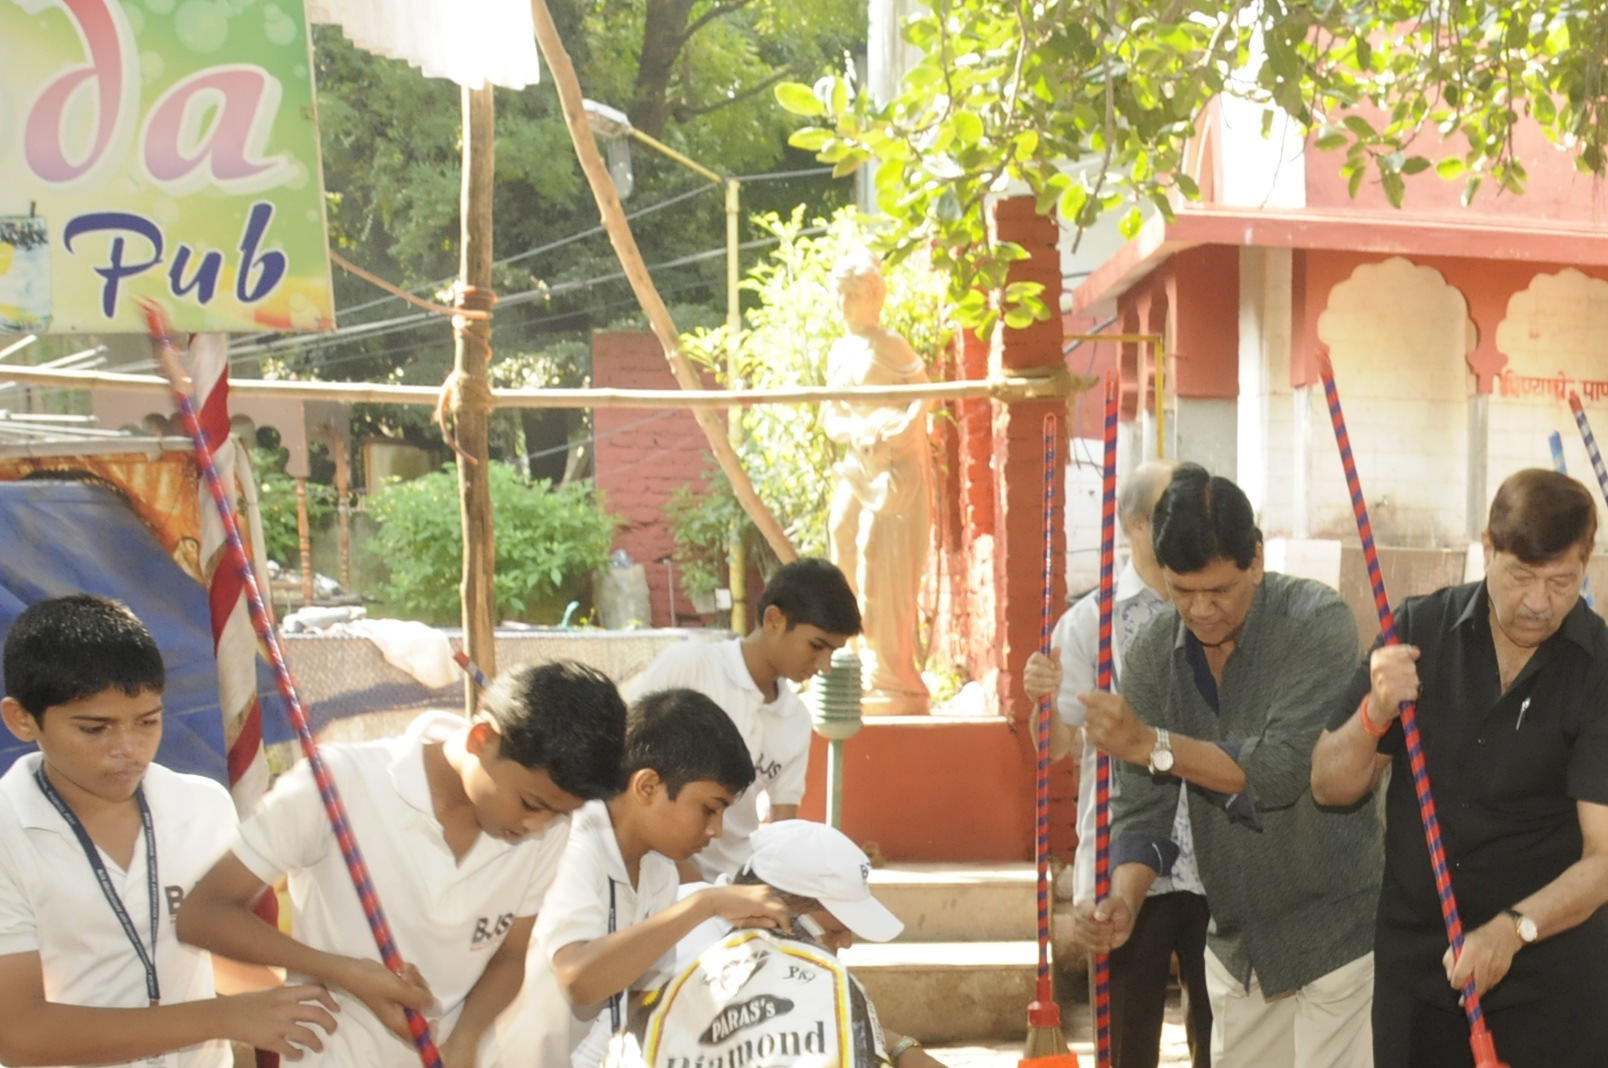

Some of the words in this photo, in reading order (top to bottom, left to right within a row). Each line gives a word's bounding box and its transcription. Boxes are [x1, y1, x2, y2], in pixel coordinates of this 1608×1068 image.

[63, 202, 287, 319] Pub
[472, 912, 514, 944] BJS
[711, 998, 777, 1044] PARAS's
